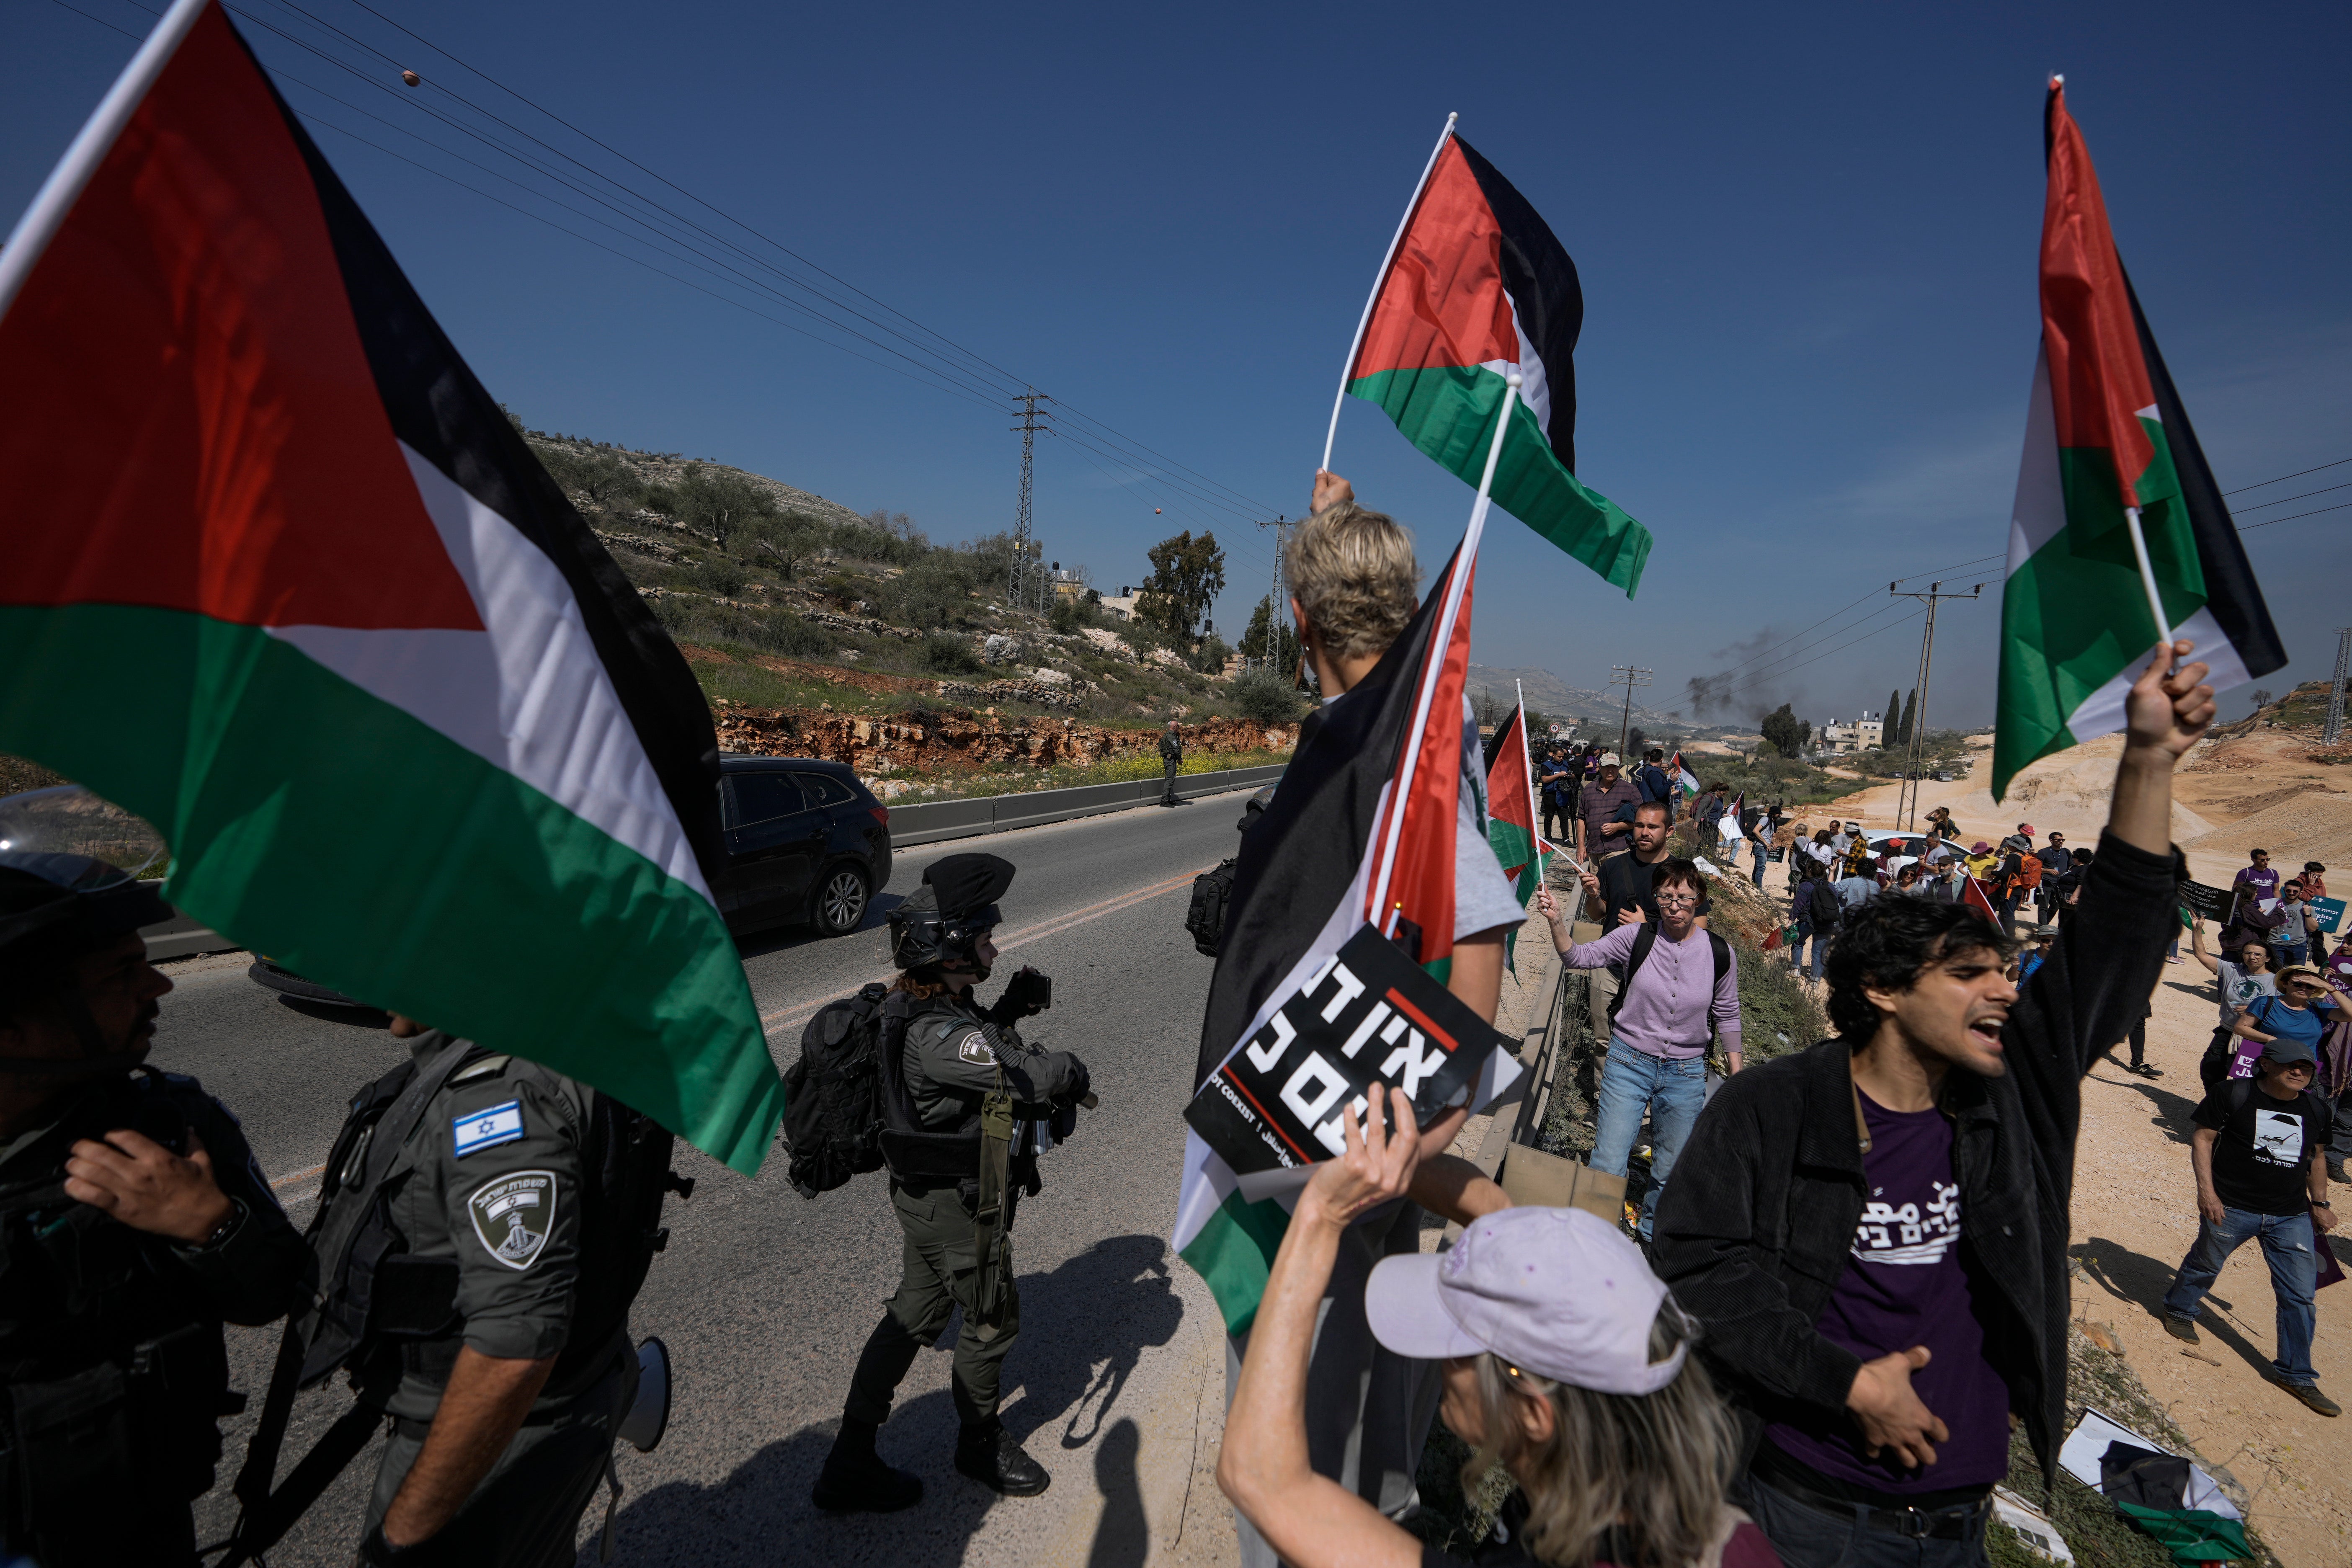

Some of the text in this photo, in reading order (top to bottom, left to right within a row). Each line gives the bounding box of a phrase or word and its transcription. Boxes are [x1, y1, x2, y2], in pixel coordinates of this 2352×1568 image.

[1221, 1084, 1256, 1124] COEXIST
[475, 1178, 548, 1208] משטרת ישראל
